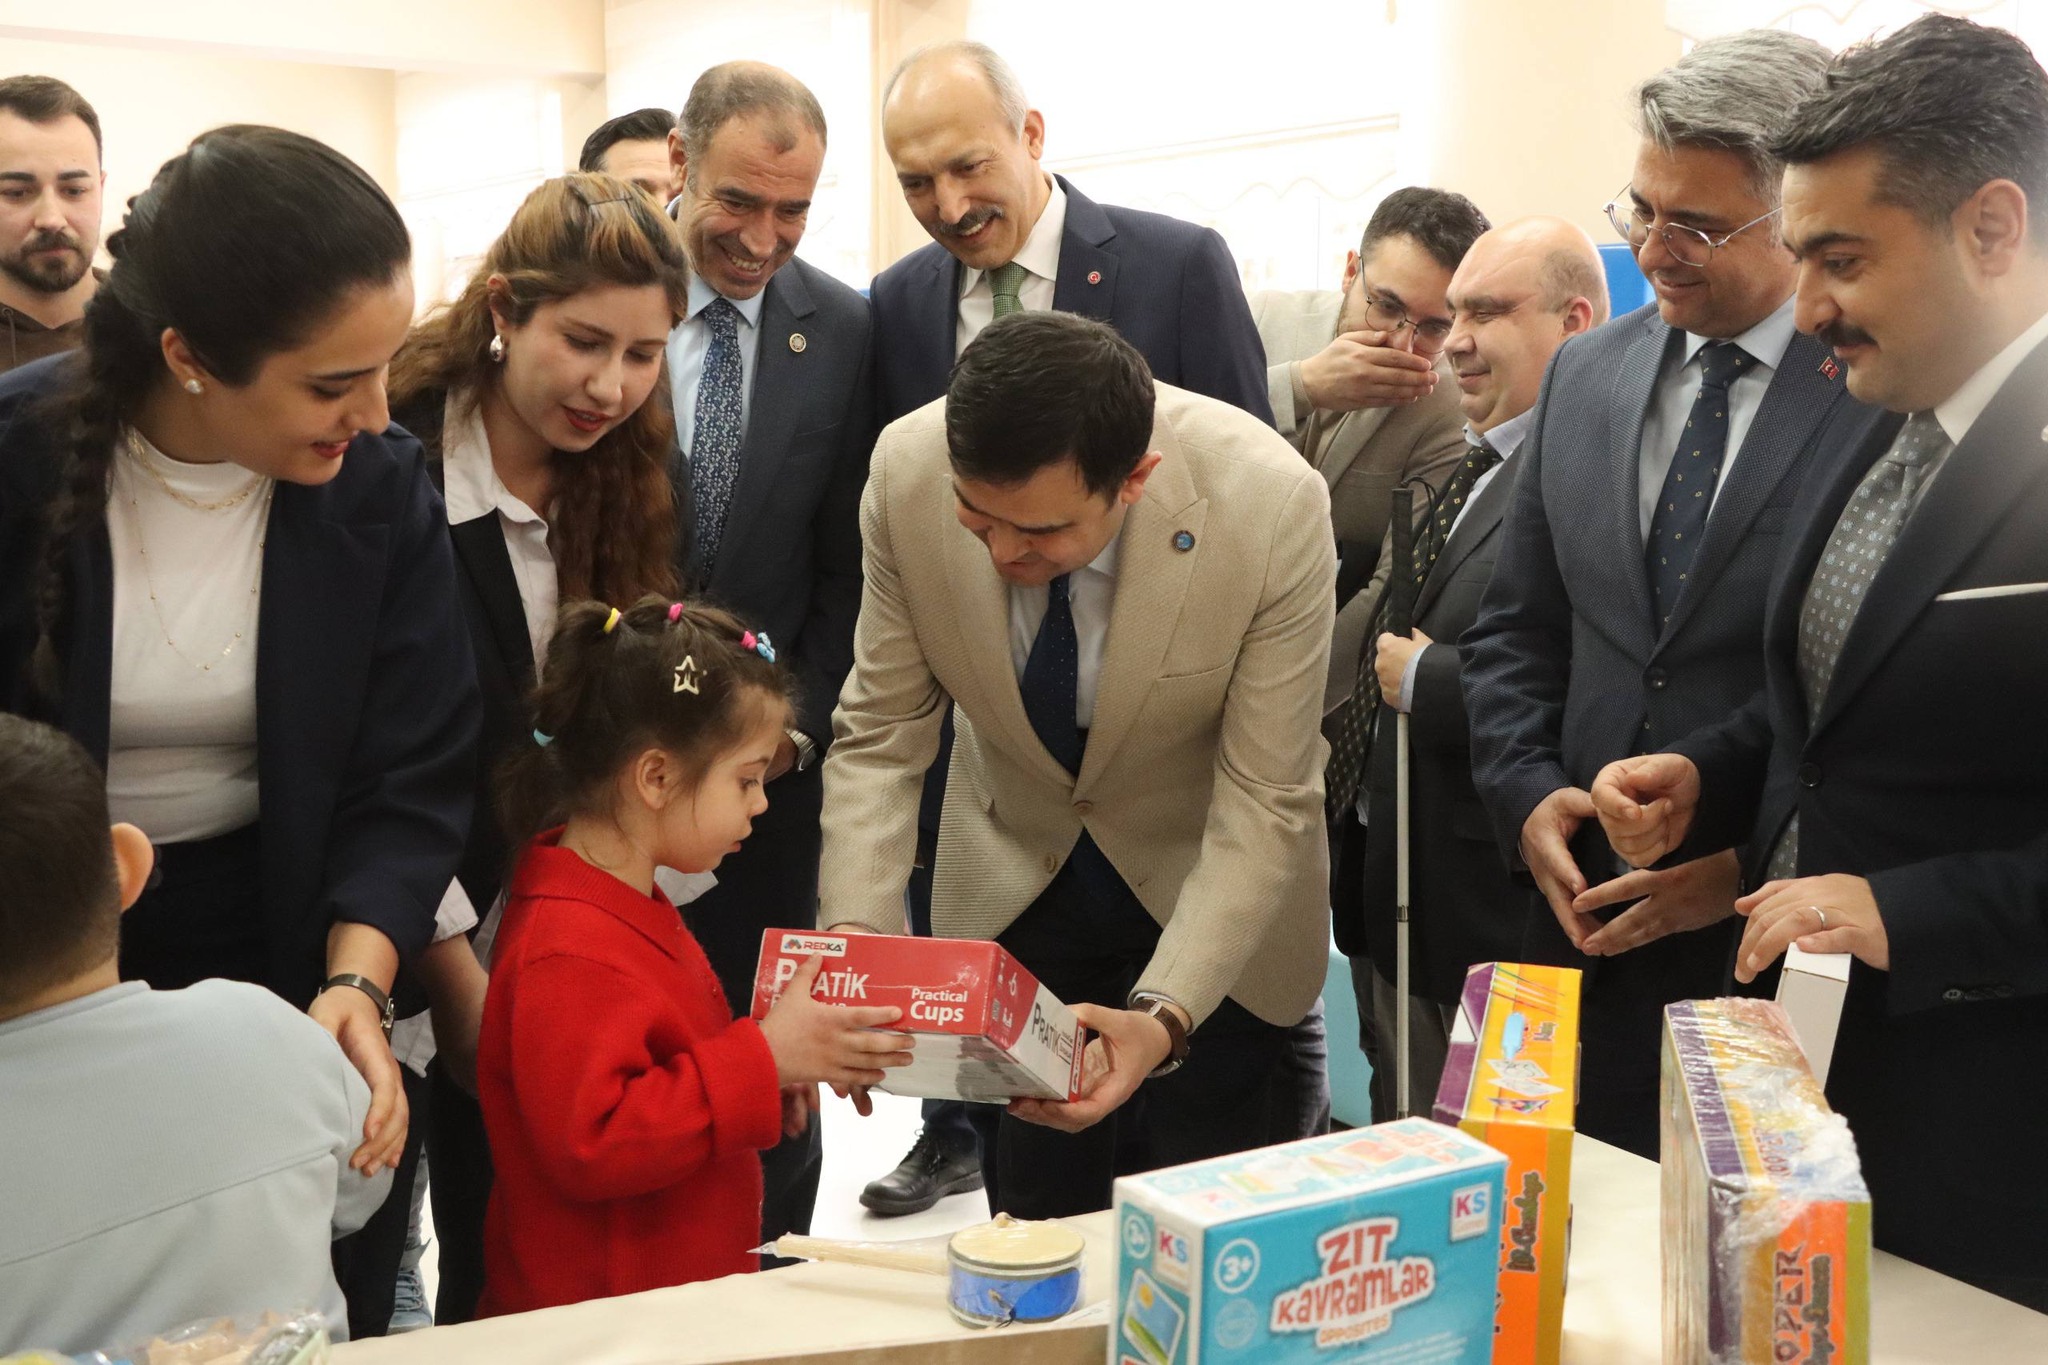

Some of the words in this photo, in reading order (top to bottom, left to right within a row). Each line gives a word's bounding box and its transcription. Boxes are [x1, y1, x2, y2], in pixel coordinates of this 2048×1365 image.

[803, 941, 844, 952] REDKA
[773, 957, 870, 999] PATİK
[911, 987, 968, 1003] Practical
[910, 1000, 965, 1026] Cups
[1456, 1190, 1487, 1218] KS
[1160, 1230, 1188, 1263] KS
[1323, 1224, 1393, 1276] ZIT
